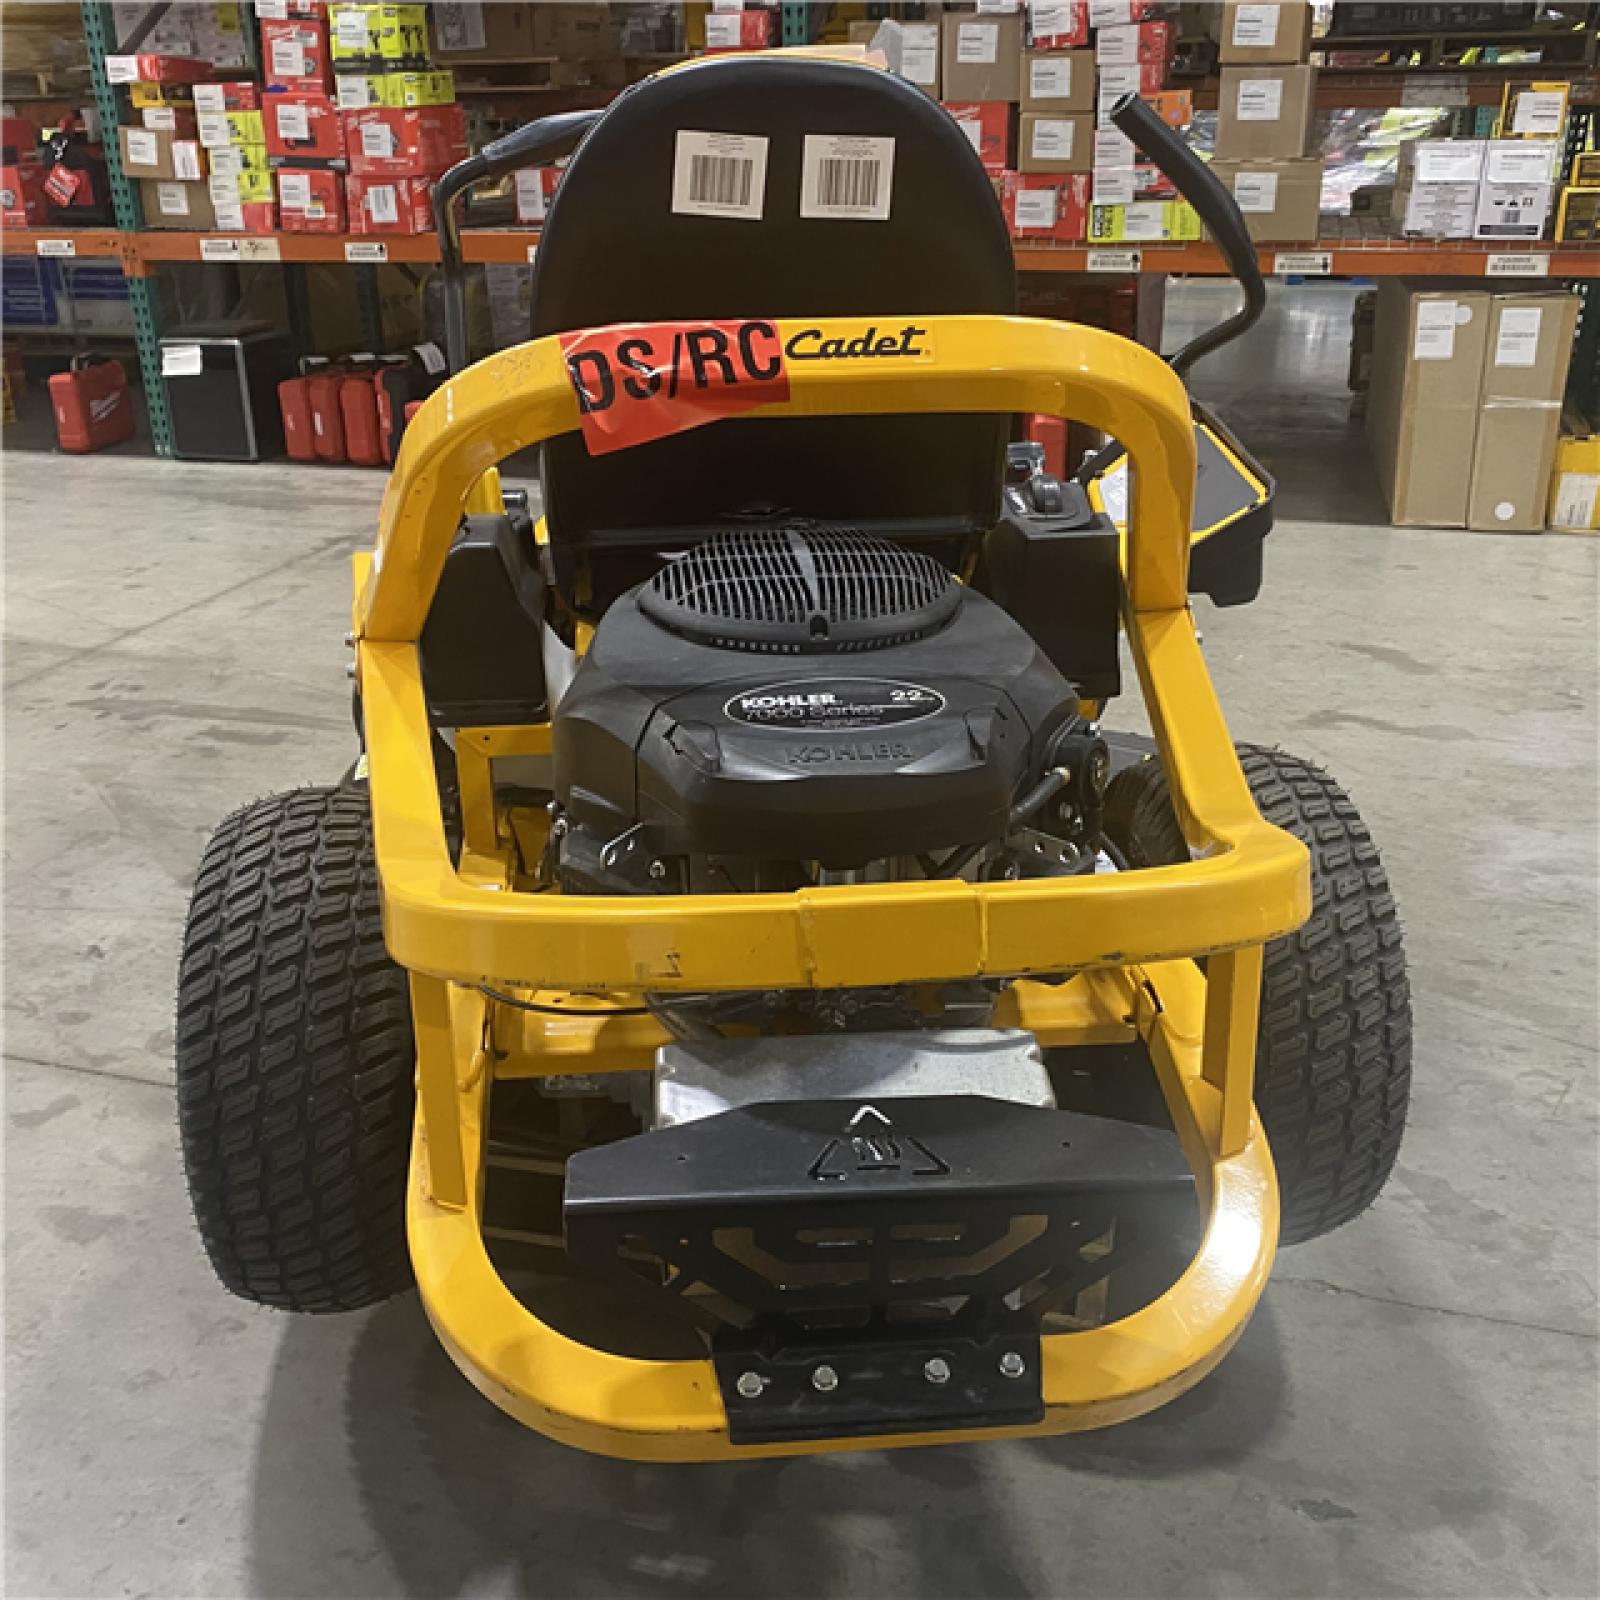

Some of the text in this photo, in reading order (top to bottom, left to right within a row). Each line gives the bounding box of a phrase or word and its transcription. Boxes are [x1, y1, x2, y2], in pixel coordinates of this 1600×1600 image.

[785, 326, 926, 360] Cadet
[567, 321, 782, 413] DS/RC
[741, 694, 837, 708] KOHLER
[785, 743, 914, 764] KOHLER
